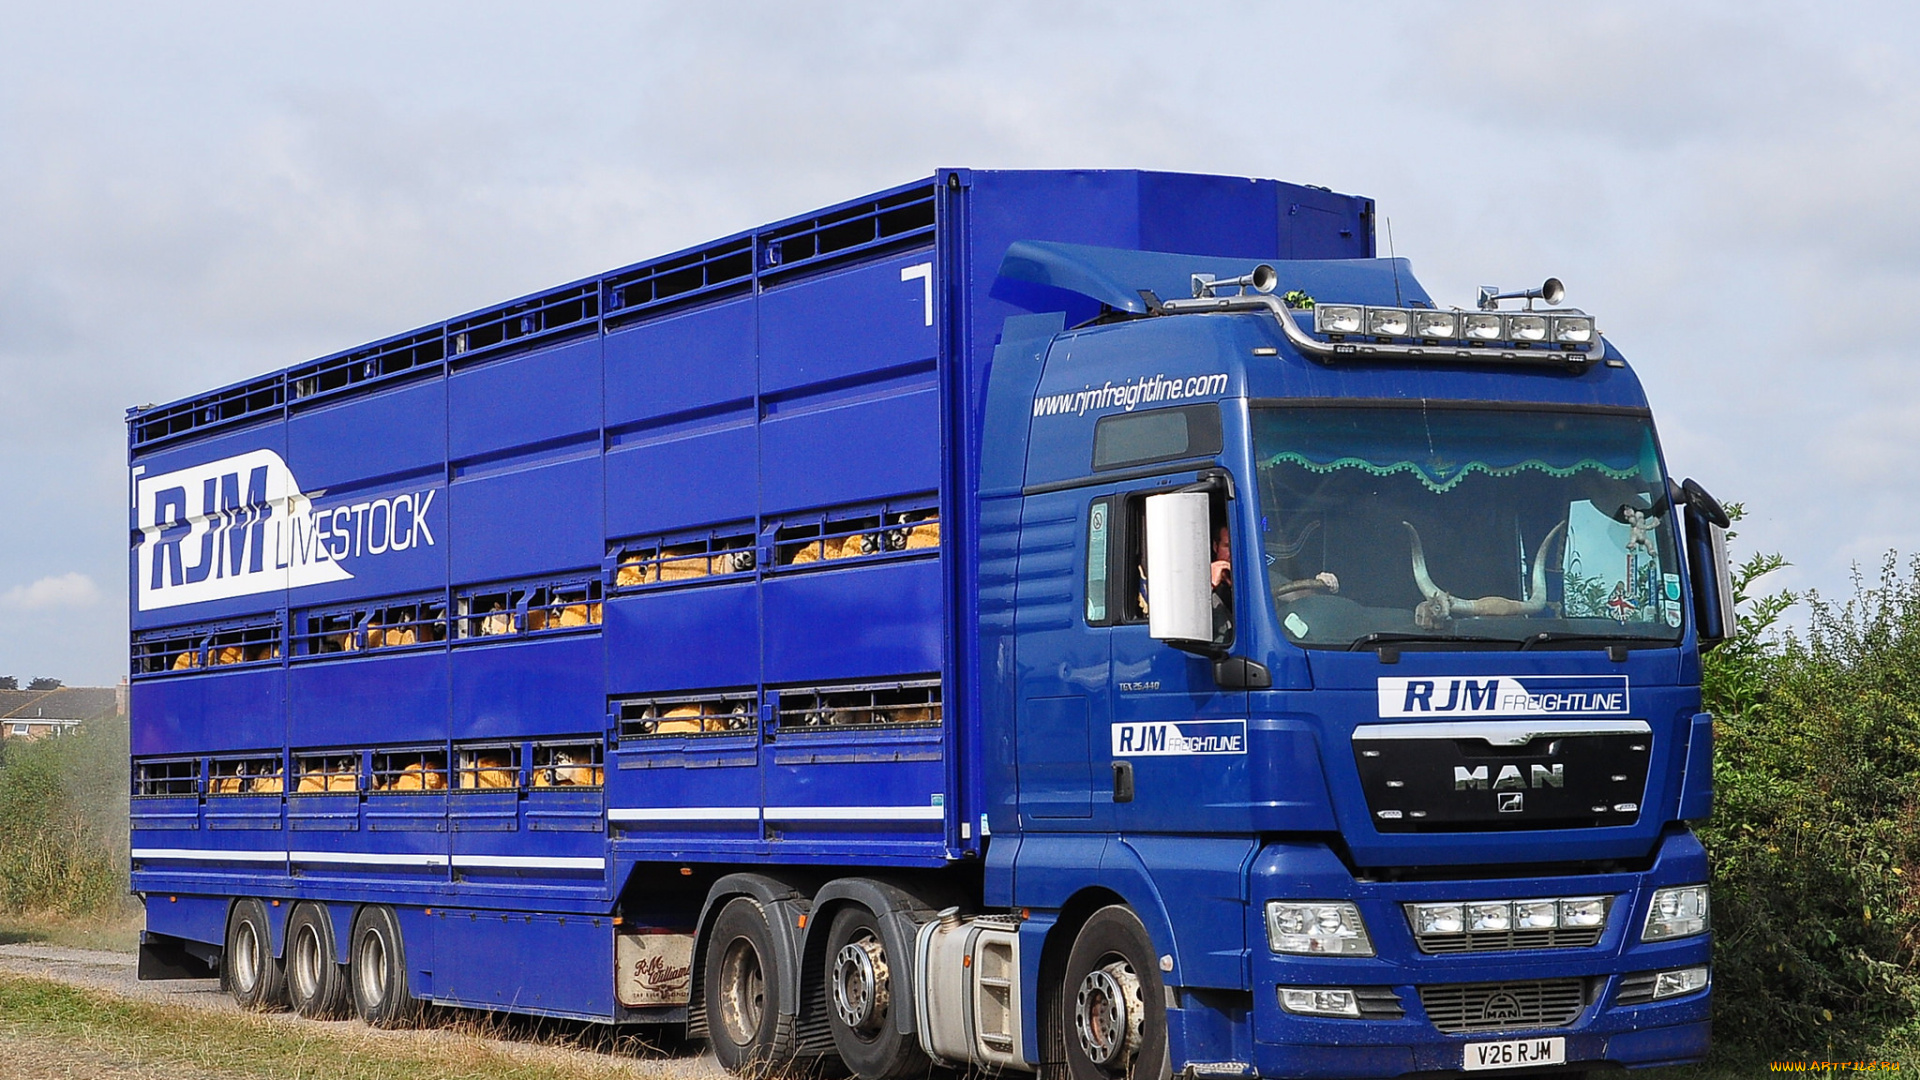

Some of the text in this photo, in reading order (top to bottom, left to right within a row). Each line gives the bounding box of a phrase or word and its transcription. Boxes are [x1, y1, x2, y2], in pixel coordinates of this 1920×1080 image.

[1033, 374, 1228, 416] www.rjmfreightline.com
[151, 465, 437, 591] RJM LIVESTOCK
[1402, 680, 1621, 712] RJM FREIGHTLINE
[1119, 725, 1242, 751] RJM FREIGHTLINE
[1454, 763, 1565, 790] MAN
[1487, 1010, 1517, 1018] MAN
[1477, 1040, 1551, 1065] V26 RJM
